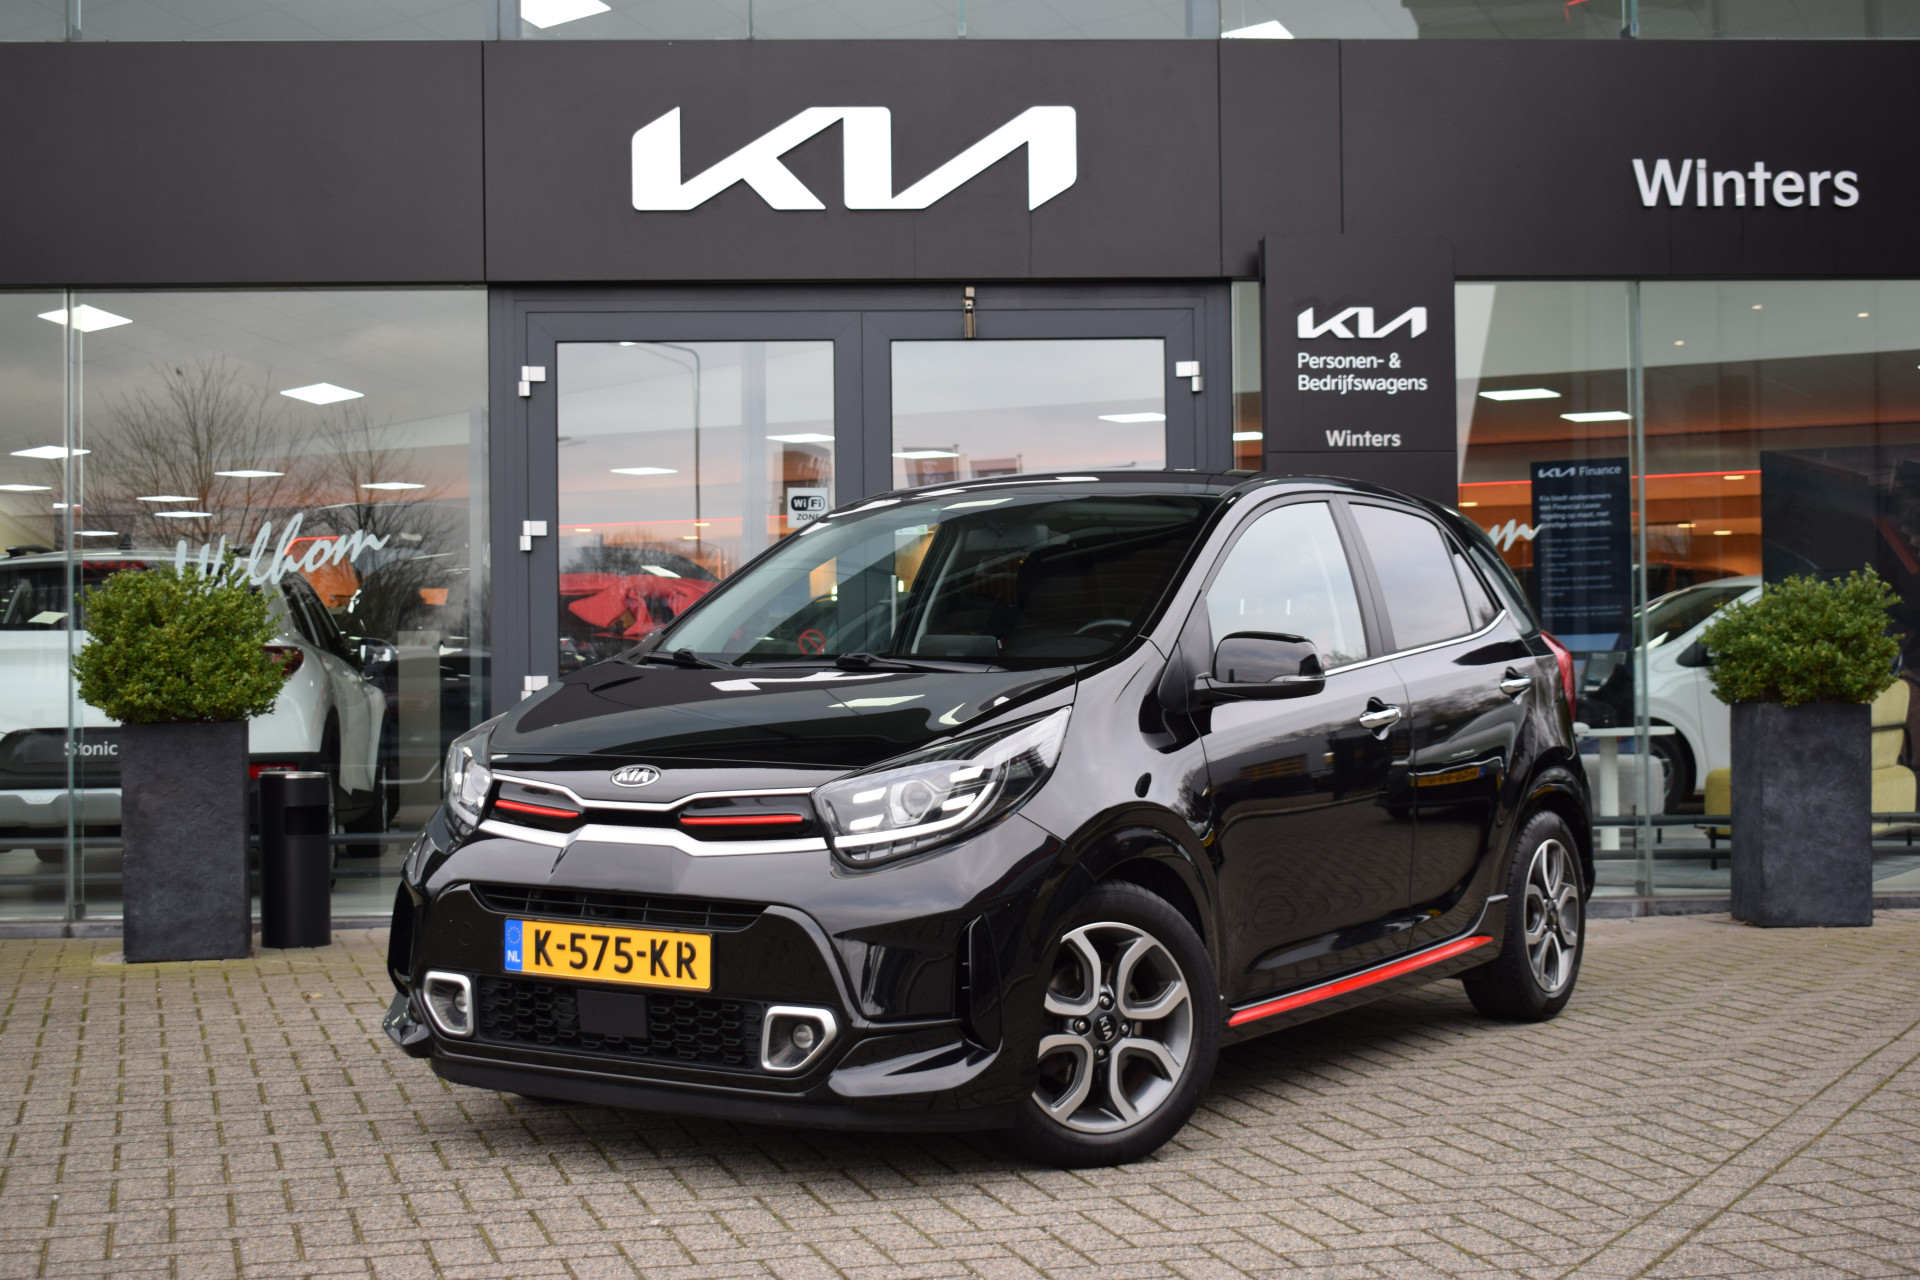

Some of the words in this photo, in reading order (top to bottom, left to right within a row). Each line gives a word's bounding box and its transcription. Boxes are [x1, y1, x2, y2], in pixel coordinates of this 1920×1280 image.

[631, 106, 1077, 211] KIA
[1632, 158, 1859, 207] Winters
[1297, 306, 1428, 339] KIA
[1297, 352, 1385, 369] Personen-
[1388, 352, 1402, 369] &
[1297, 374, 1428, 395] Bedrijfswagens
[1325, 429, 1402, 447] Winters
[1537, 467, 1577, 478] KIA
[1579, 465, 1621, 477] Finance
[64, 740, 119, 756] Stonic
[507, 950, 521, 963] NL
[533, 928, 698, 980] K-575-KR
